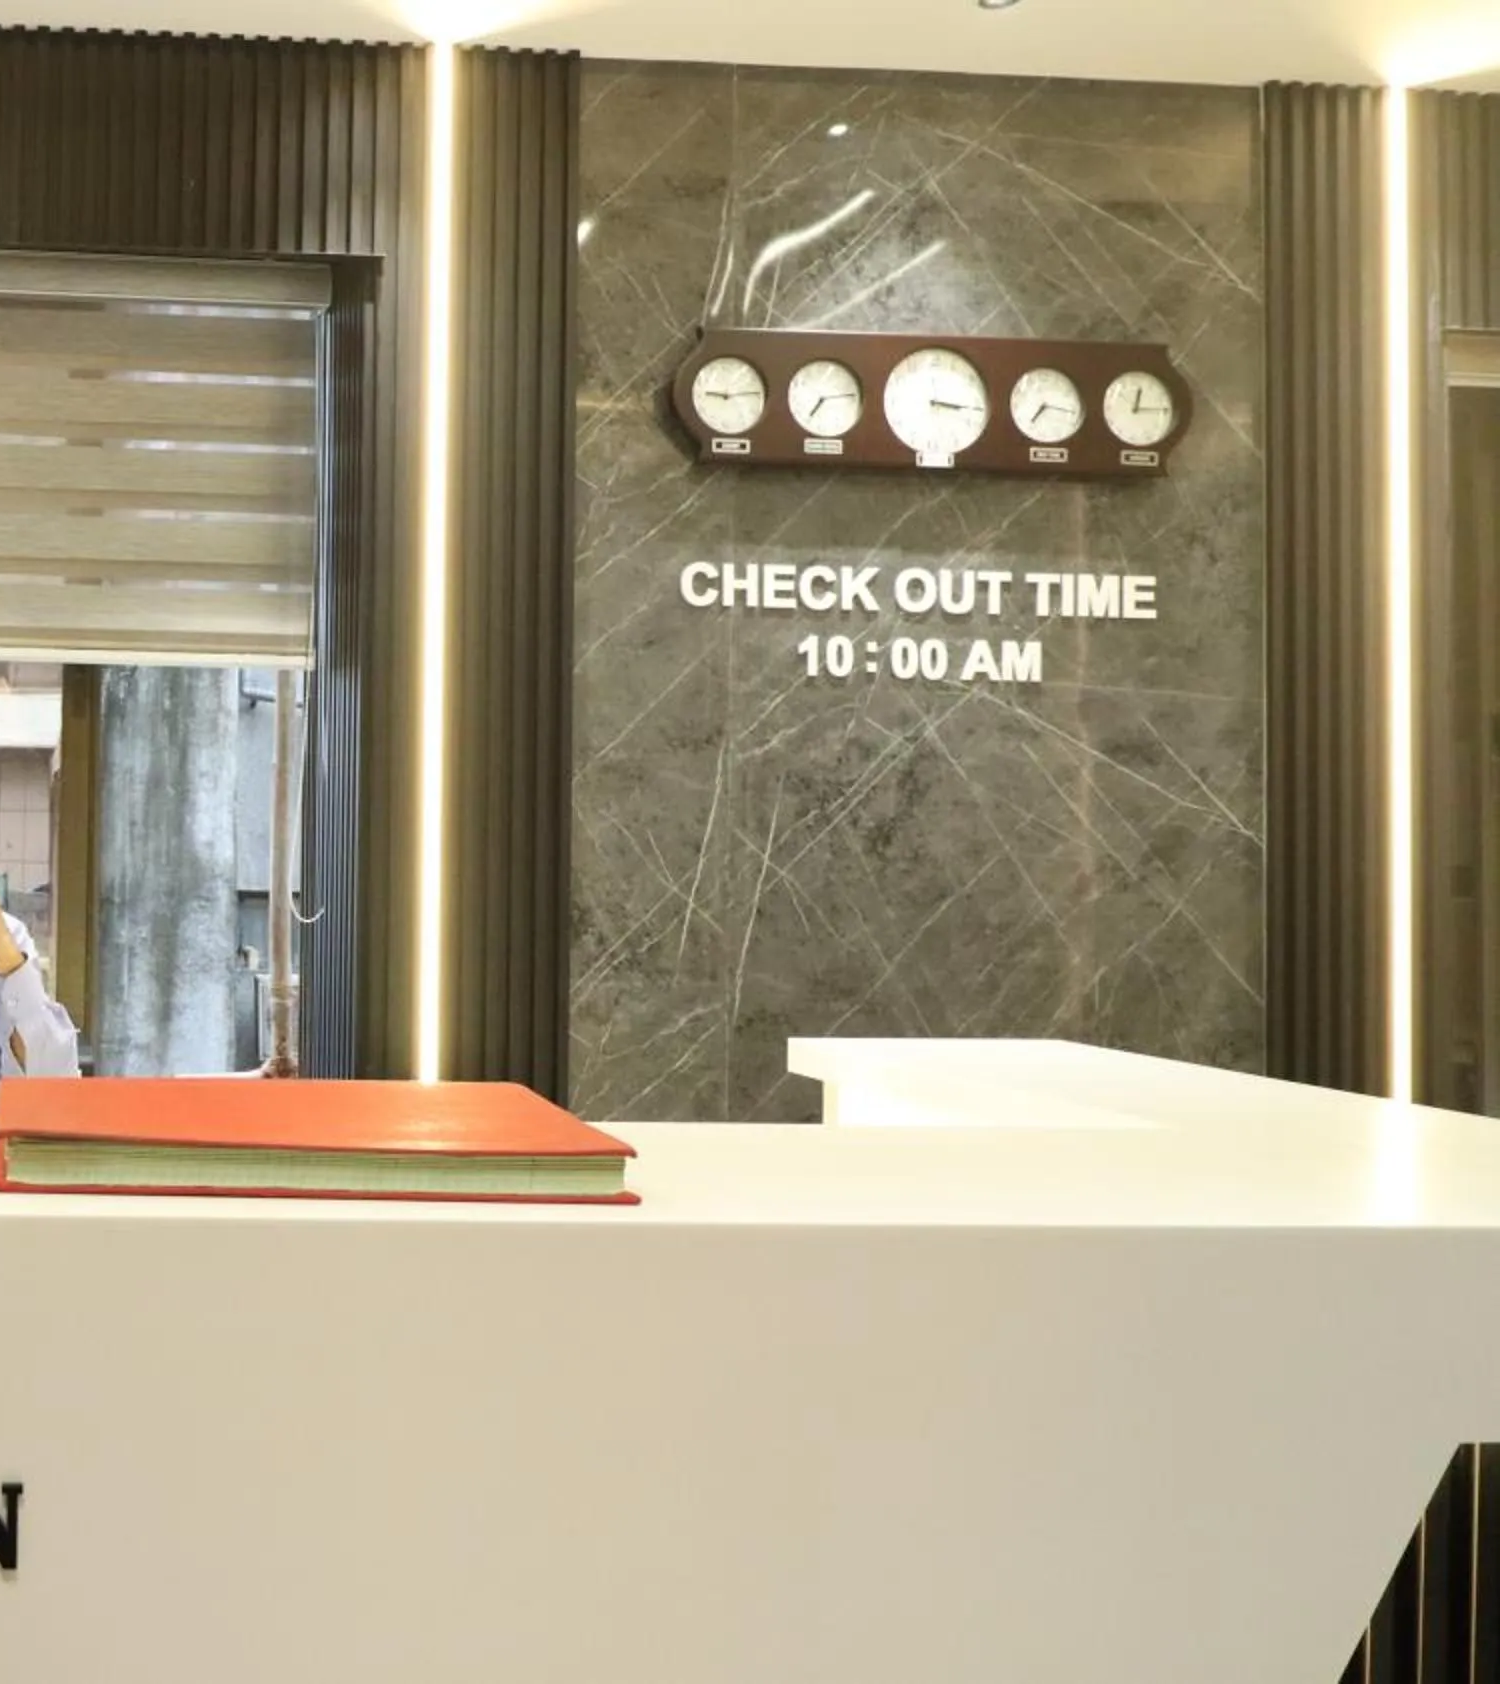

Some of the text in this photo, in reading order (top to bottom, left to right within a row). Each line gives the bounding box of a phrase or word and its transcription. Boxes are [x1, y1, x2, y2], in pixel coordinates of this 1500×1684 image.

[679, 560, 1158, 619] CHECK OUT TIME
[959, 639, 1042, 682] AM
